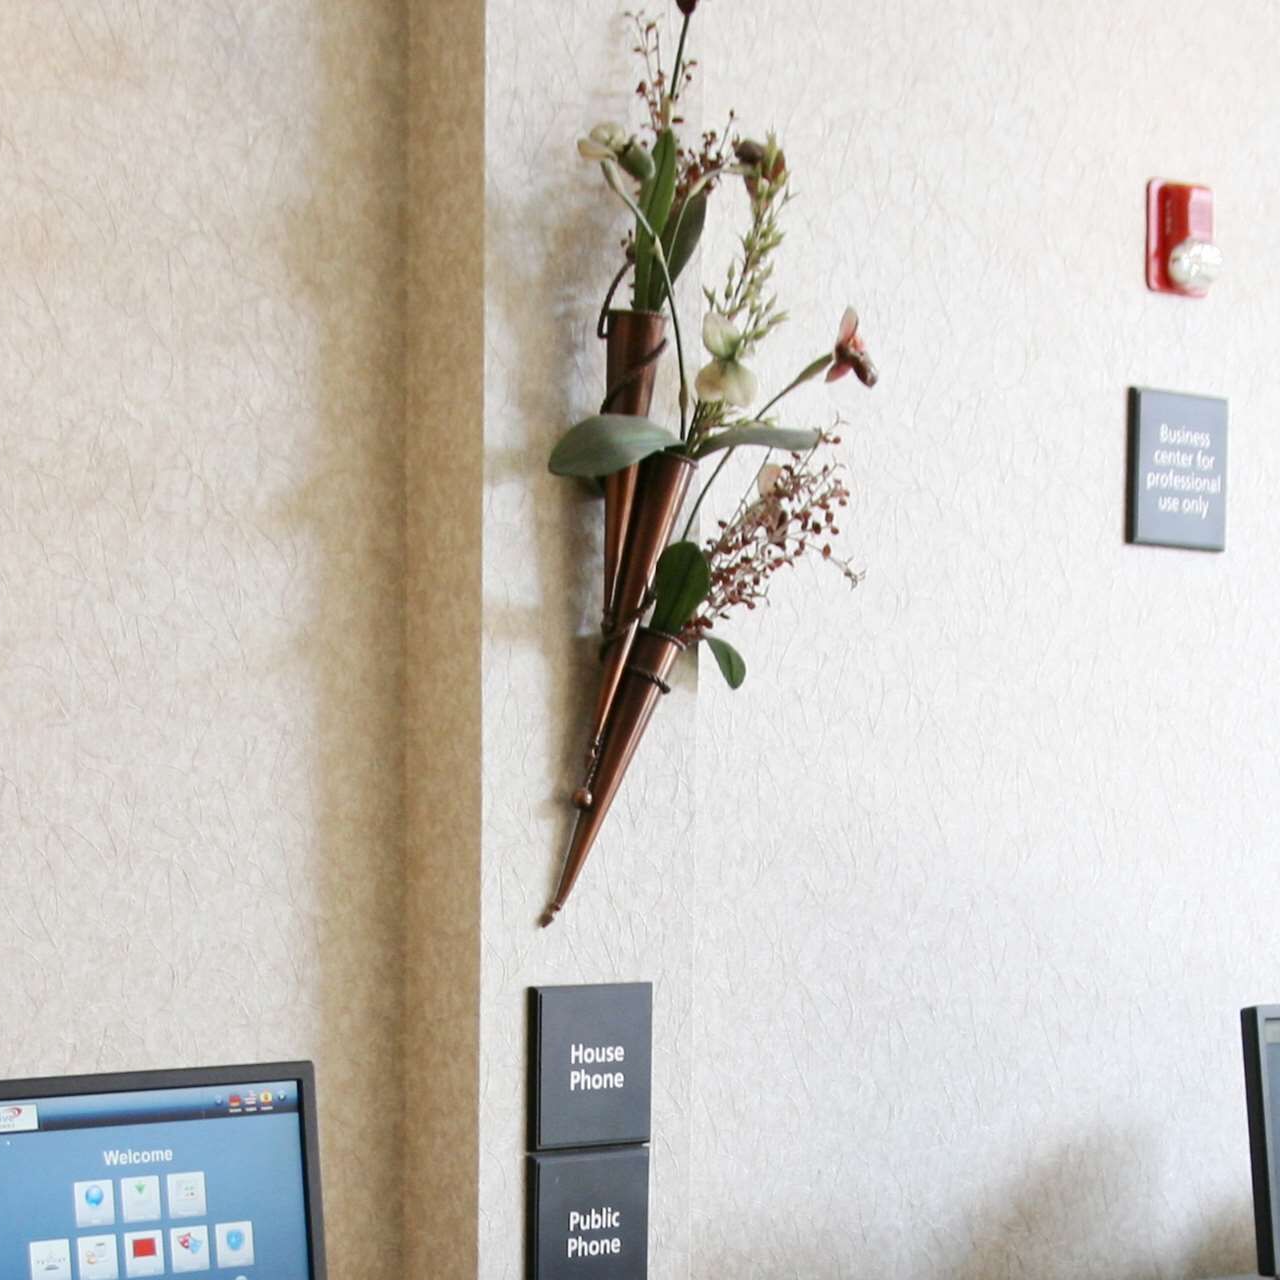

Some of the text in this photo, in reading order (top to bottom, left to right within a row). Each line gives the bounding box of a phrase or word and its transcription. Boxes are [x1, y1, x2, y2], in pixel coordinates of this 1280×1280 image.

[1160, 423, 1210, 449] Business
[1154, 449, 1215, 469] center for
[1146, 468, 1221, 494] professional
[1158, 495, 1208, 519] use only
[571, 1043, 624, 1064] House
[570, 1069, 624, 1091] Phone
[103, 1148, 173, 1166] Welcome
[569, 1207, 620, 1231] Public
[567, 1236, 621, 1258] Phone
